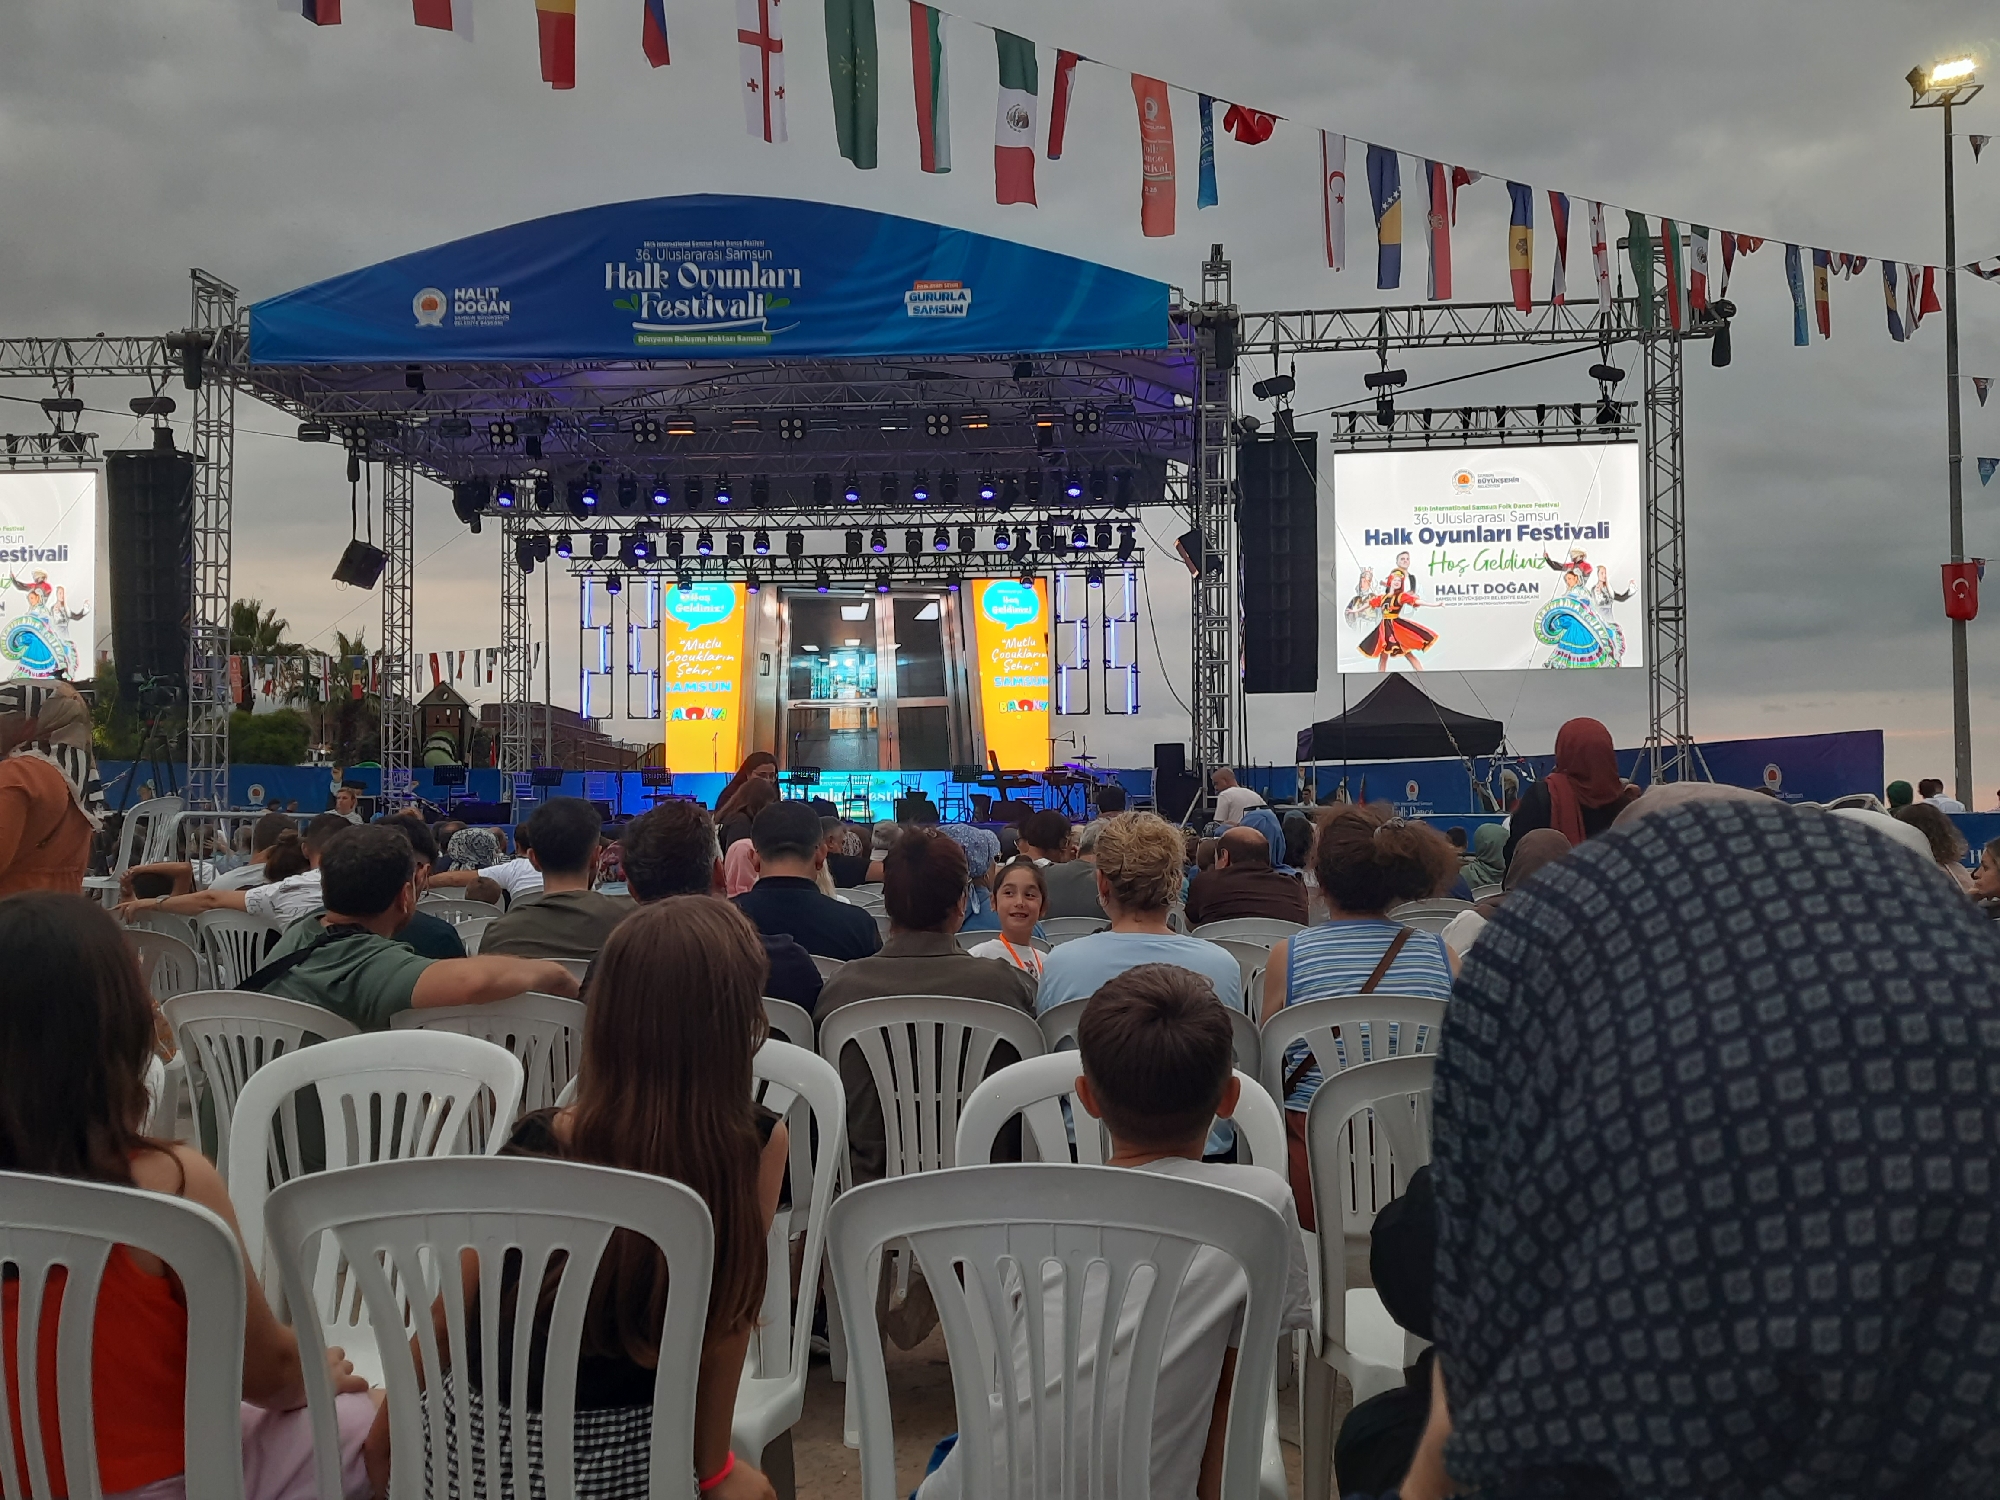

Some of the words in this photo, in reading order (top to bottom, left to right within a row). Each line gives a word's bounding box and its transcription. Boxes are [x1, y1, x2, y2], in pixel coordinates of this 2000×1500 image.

[635, 249, 653, 261] 36.
[656, 248, 723, 262] Uluslararası
[725, 248, 773, 261] Samsun
[604, 262, 670, 290] Halk
[677, 261, 801, 295] Oyunları
[908, 290, 967, 302] GURURLA
[454, 299, 511, 314] DOĞAN
[640, 291, 765, 320] Festivali
[912, 304, 964, 315] SAMSUN
[1429, 504, 1471, 512] International
[1413, 513, 1432, 525] 36.
[1436, 512, 1506, 525] Uluslararası
[1510, 510, 1559, 523] Samsun
[1364, 528, 1413, 546] Halk
[1418, 526, 1511, 548] Oyunları
[1517, 522, 1610, 542] Festivali
[1428, 550, 1470, 577] Hoş
[1473, 548, 1547, 573] Geldiniz
[1483, 582, 1540, 594] DOĞAN
